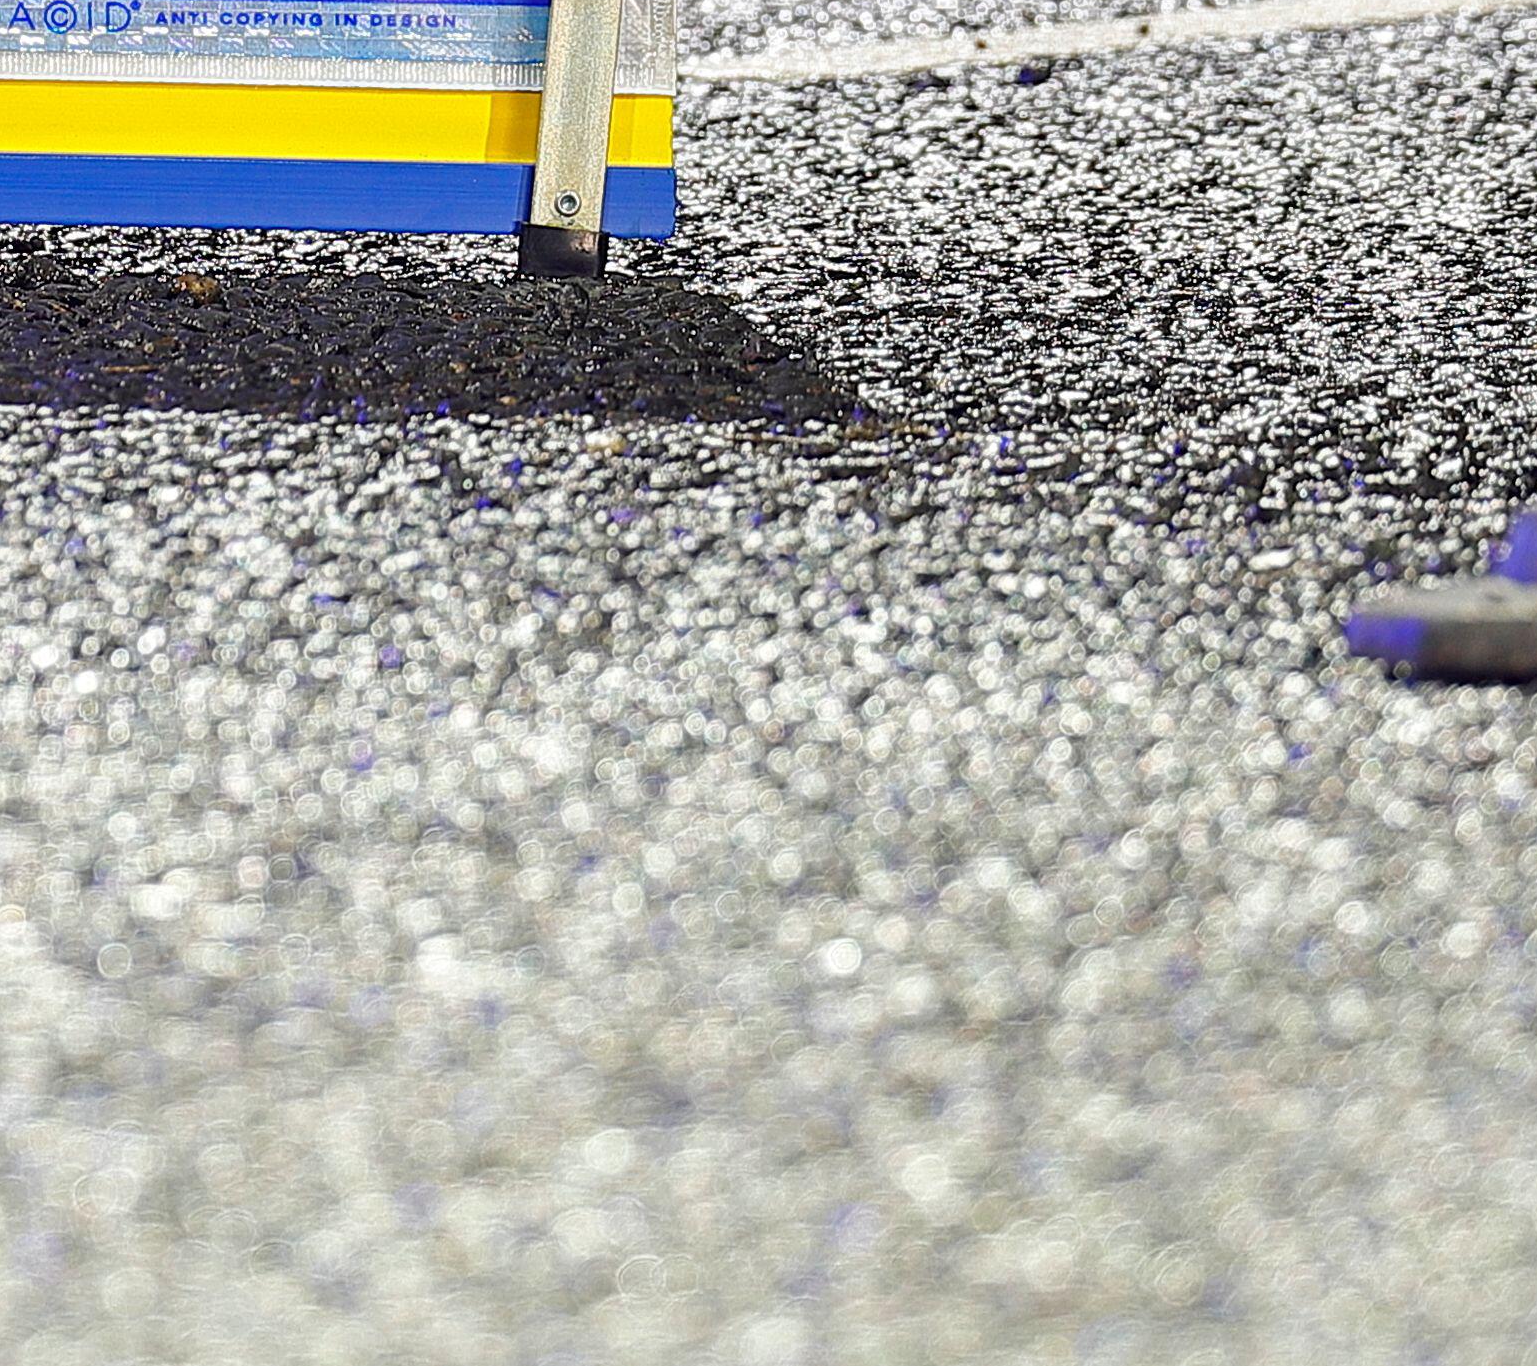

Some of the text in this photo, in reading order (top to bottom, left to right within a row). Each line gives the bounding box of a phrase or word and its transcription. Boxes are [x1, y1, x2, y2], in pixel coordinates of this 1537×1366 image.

[155, 12, 208, 25] ANTI
[219, 12, 323, 27] COPYING
[335, 13, 357, 26] IN
[369, 14, 457, 28] DESIGN
